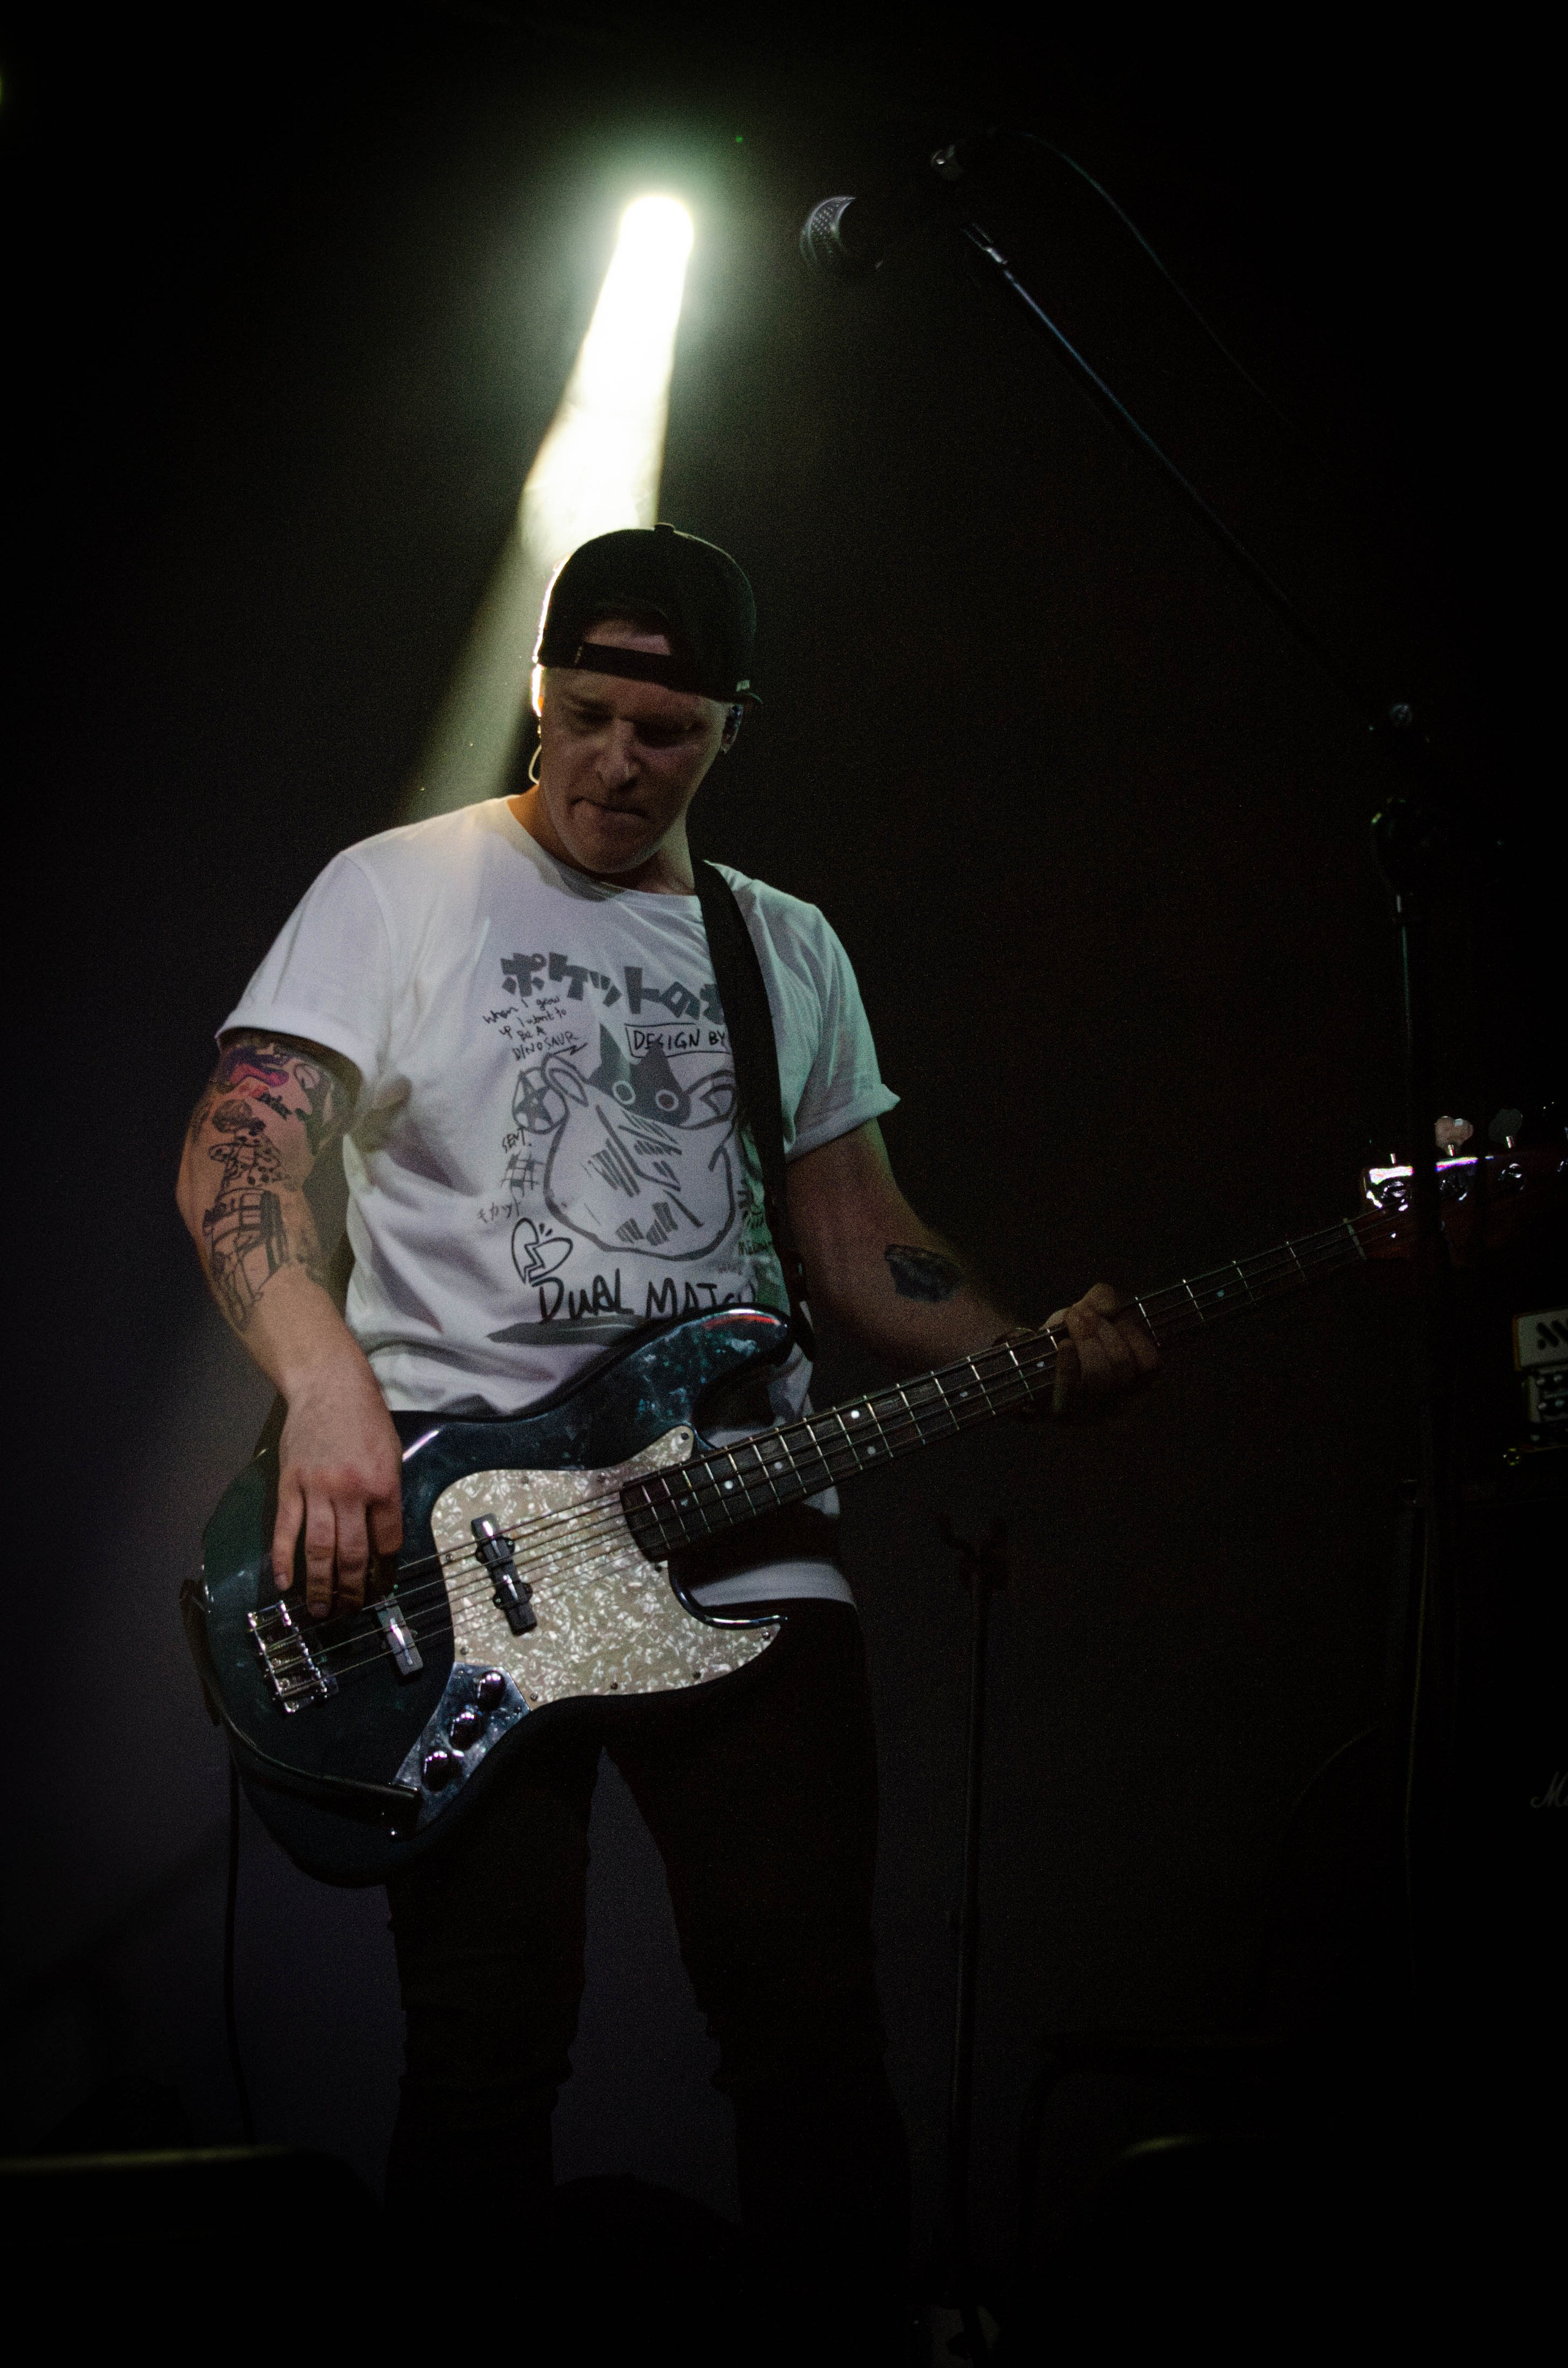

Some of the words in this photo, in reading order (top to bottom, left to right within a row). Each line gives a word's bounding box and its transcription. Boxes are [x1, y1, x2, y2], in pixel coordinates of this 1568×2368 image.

[511, 1031, 580, 1061] DINOSAUR
[633, 1028, 701, 1050] DESIGN
[708, 1031, 726, 1047] BY
